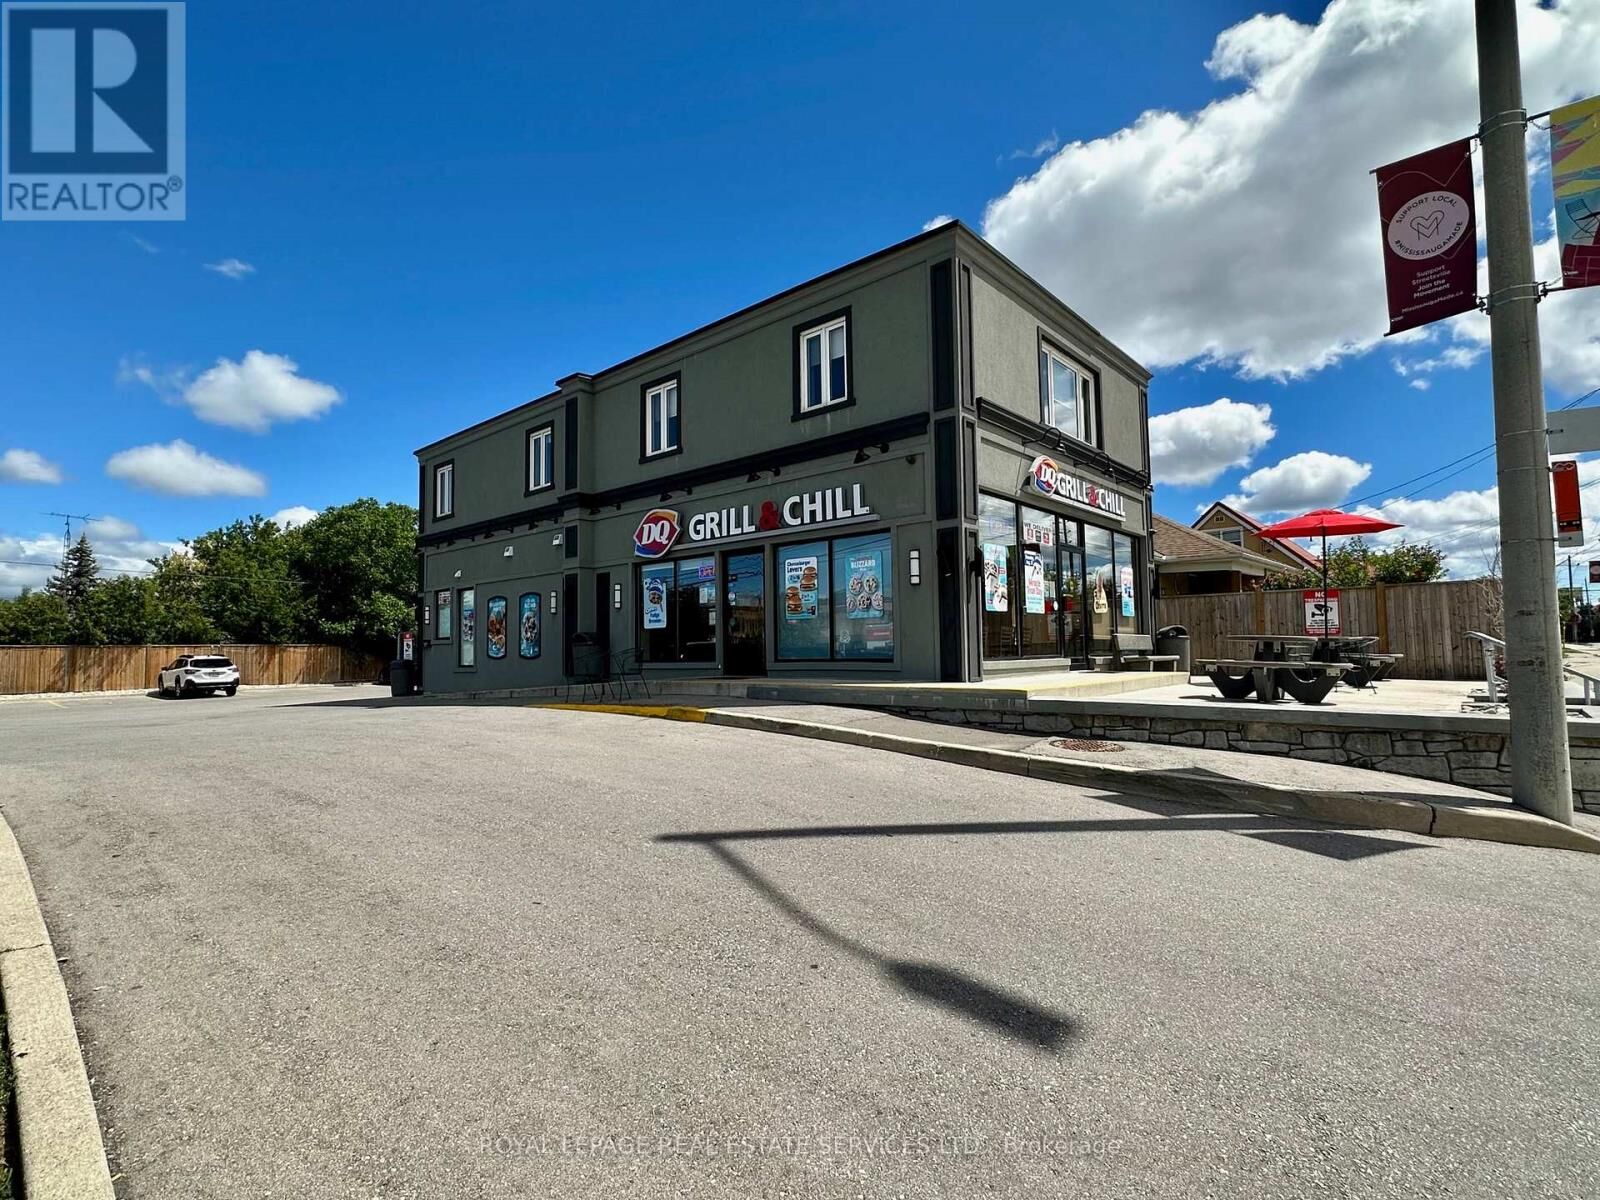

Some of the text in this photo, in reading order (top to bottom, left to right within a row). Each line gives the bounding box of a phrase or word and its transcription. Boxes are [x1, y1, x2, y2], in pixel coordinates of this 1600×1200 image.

[1396, 195, 1457, 223] SUPPORT LOCAL
[1416, 265, 1446, 278] Support
[1413, 283, 1451, 299] Movement
[1418, 279, 1446, 291] Join the
[1041, 464, 1126, 517] DQ GRILL & CHILL
[641, 483, 870, 546] DQ GRILL & CHILL
